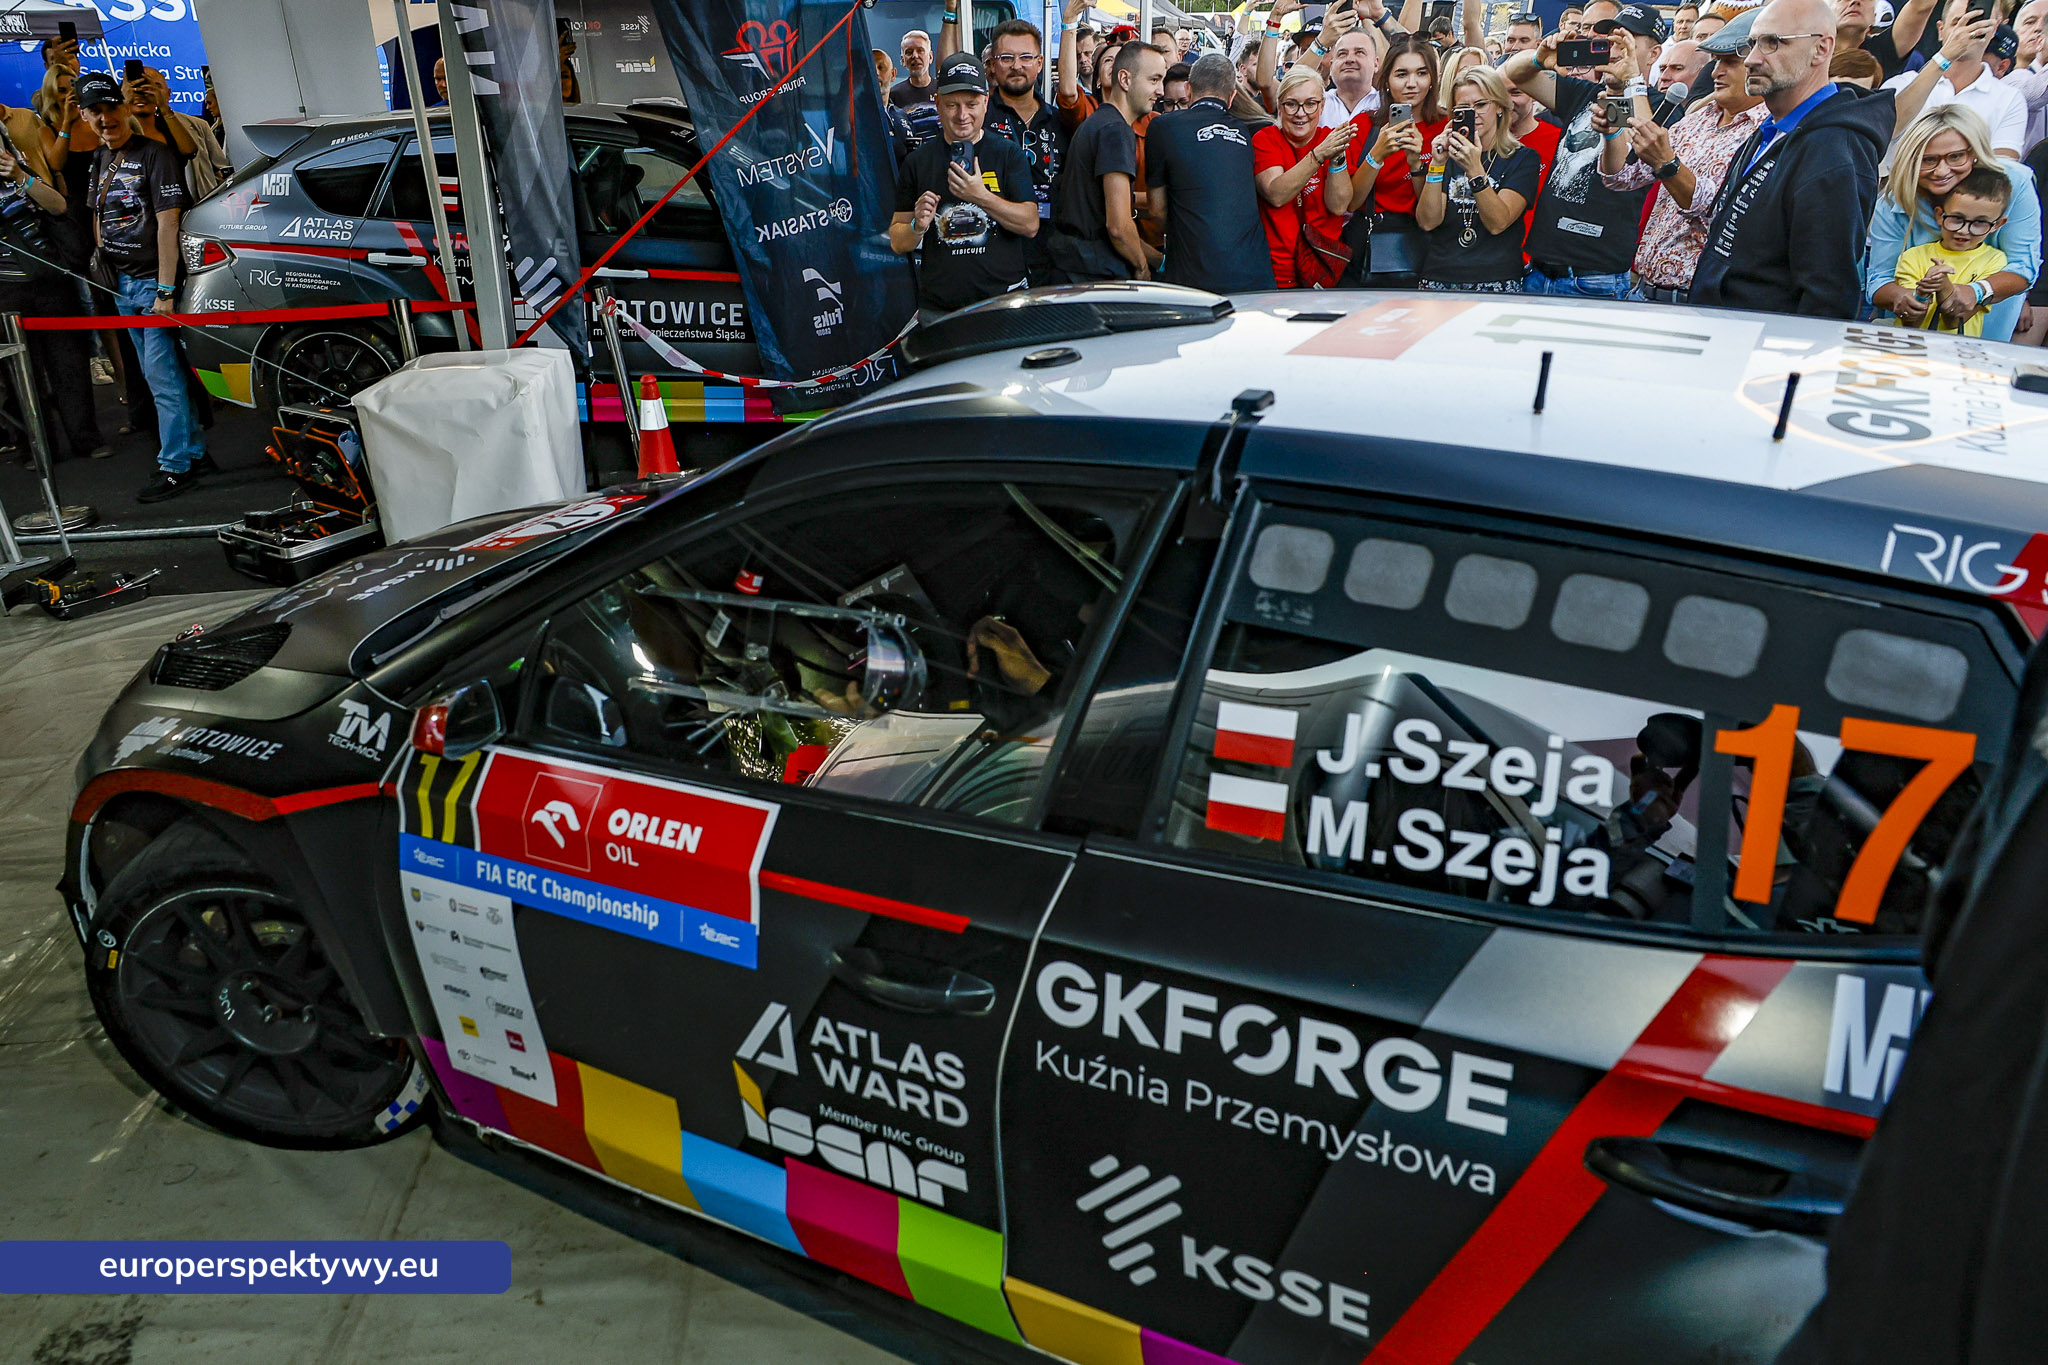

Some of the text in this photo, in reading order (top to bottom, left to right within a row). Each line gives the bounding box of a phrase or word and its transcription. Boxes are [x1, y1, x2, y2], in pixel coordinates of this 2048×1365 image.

[76, 42, 171, 58] Katowicka
[303, 217, 354, 230] ATLAS
[303, 228, 352, 241] WARD
[204, 299, 235, 312] KSSE
[249, 269, 283, 287] RIG
[285, 271, 321, 279] REGIONALNA
[291, 283, 329, 291] KATOWICACH
[715, 327, 746, 341] Śląska
[1880, 523, 2029, 595] RIG
[173, 724, 283, 762] KATOWICE
[1316, 712, 1616, 817] J.Szeja
[417, 751, 482, 845] 17
[1714, 703, 1978, 925] 17
[605, 842, 639, 868] OIL
[607, 807, 703, 854] ORLEN
[1306, 795, 1611, 907] M.Szeja
[476, 860, 660, 931] FIA ERC Championship
[810, 1015, 966, 1090] ATLAS
[1035, 959, 1514, 1136] GKFORGE
[811, 1052, 969, 1128] WARD
[1035, 1040, 1497, 1195] Kuźnia Przemysłowa
[819, 1103, 966, 1165] Member IMC Group
[1181, 1234, 1370, 1338] KSSE
